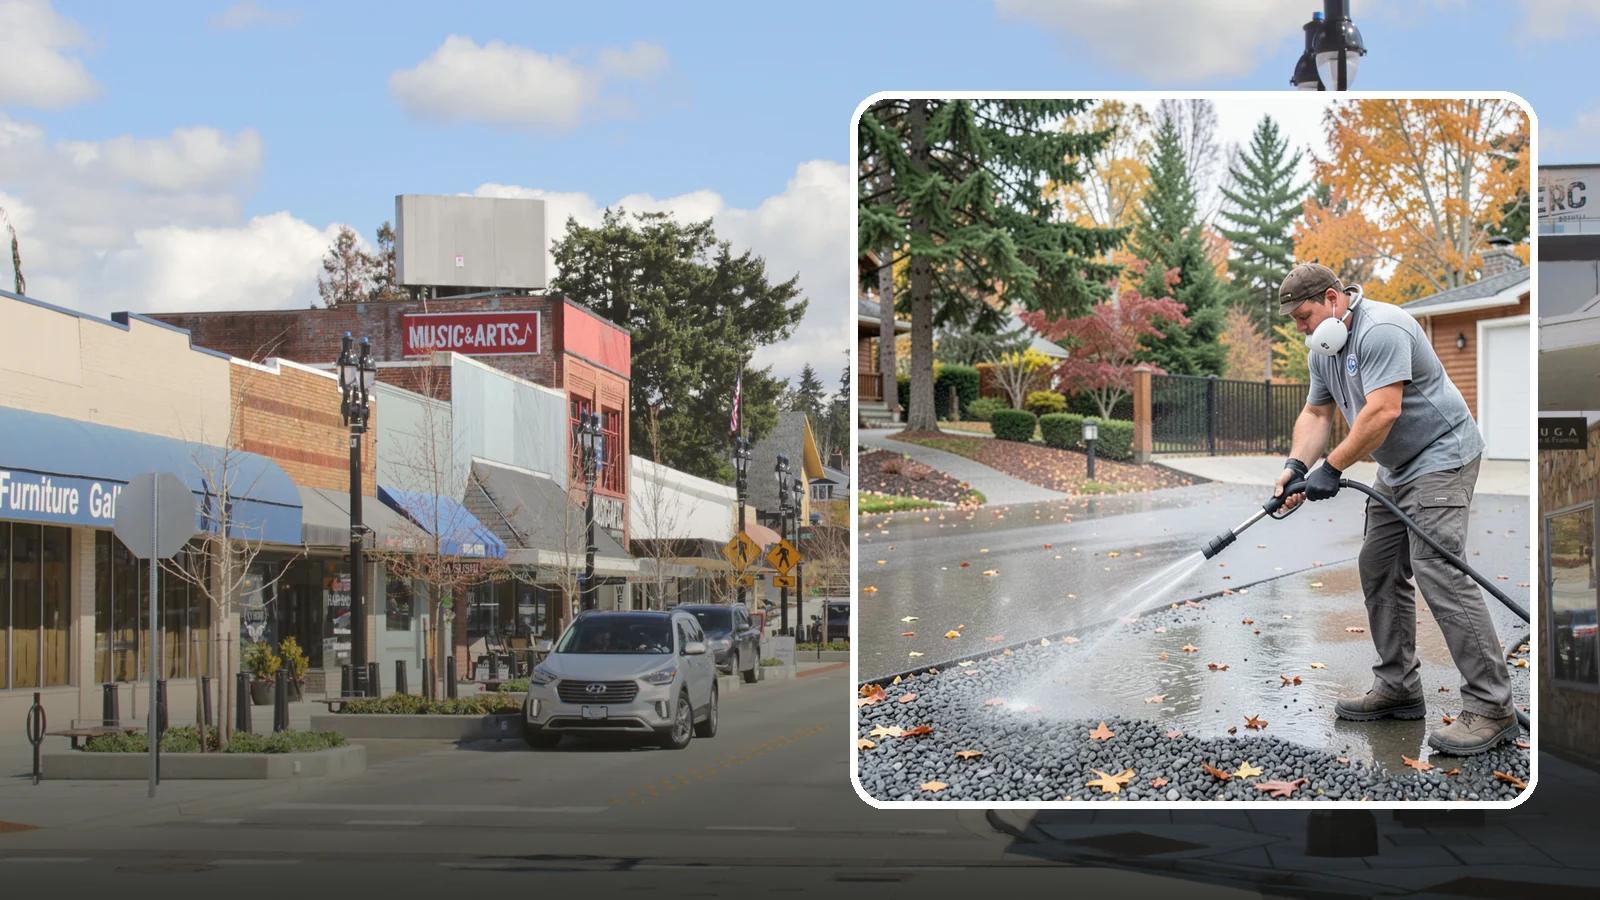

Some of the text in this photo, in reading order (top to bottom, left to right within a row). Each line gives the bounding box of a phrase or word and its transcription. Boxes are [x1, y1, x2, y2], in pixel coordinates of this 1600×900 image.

[409, 323, 519, 348] MUSIC&ARTS
[1541, 428, 1577, 437] UGA
[0, 472, 79, 515] Furniture
